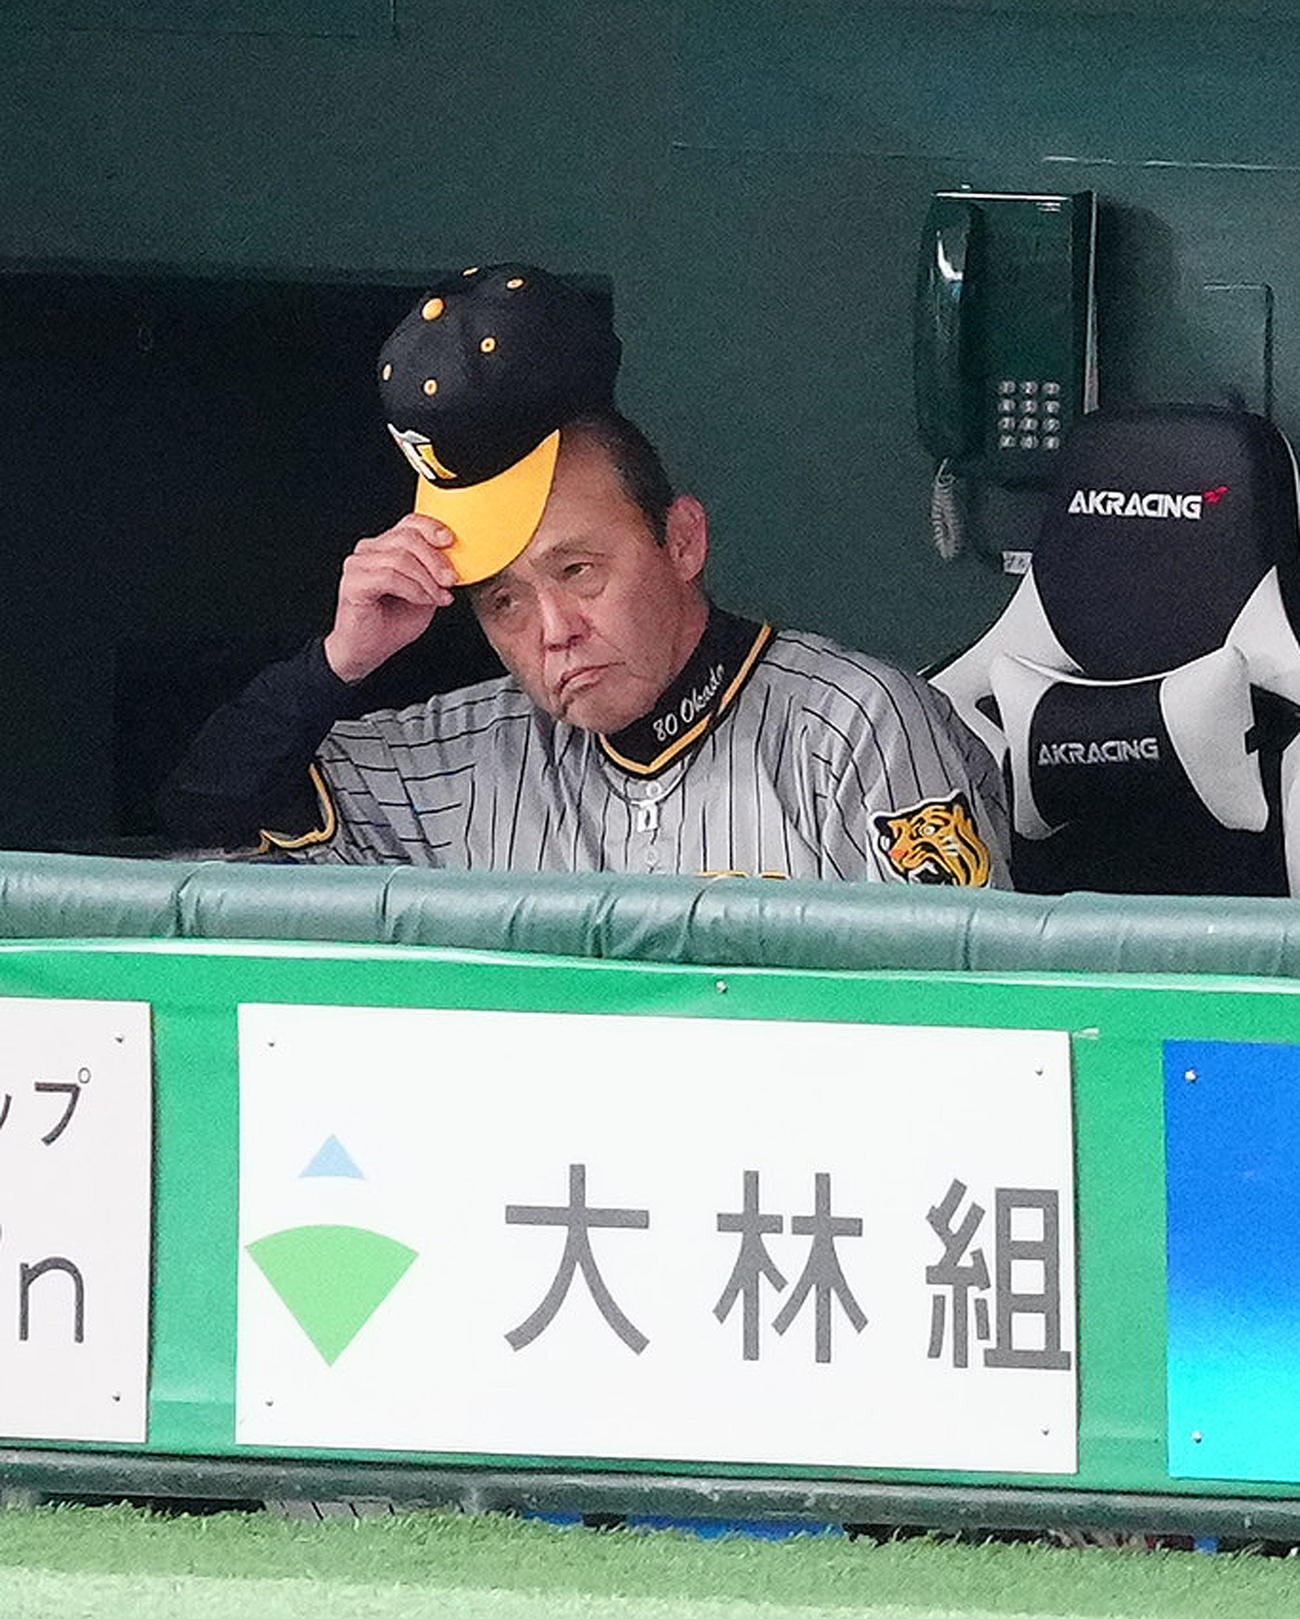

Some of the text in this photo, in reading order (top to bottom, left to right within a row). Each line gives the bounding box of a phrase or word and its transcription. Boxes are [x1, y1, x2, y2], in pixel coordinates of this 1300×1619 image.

[1068, 490, 1202, 519] AKRACING
[653, 712, 678, 741] 80
[1037, 737, 1159, 765] AKRACING
[0, 1067, 91, 1146] プ
[504, 1164, 1072, 1371] 大林組
